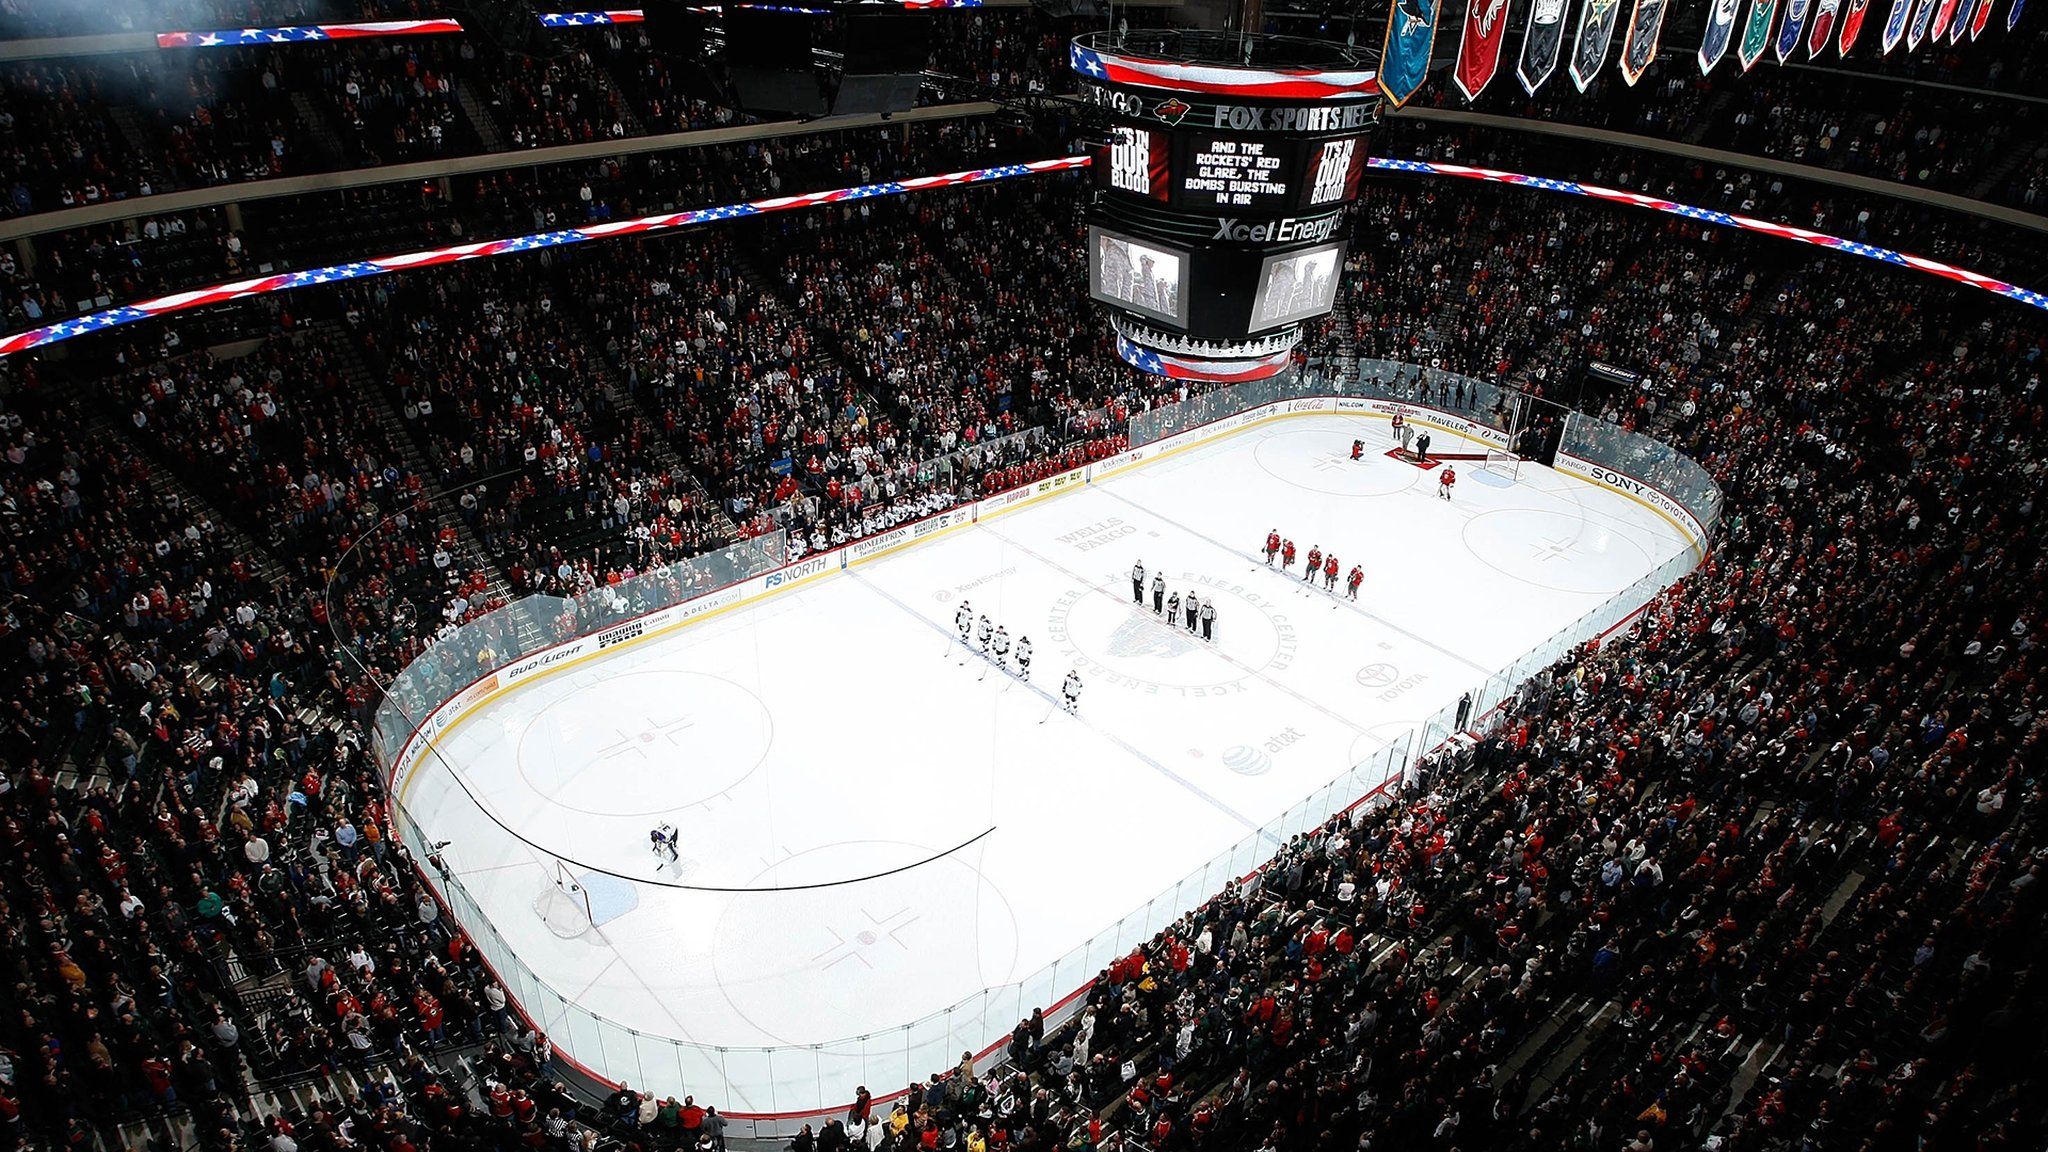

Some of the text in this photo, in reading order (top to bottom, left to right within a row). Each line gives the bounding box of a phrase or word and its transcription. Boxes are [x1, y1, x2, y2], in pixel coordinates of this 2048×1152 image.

[1214, 104, 1367, 131] FOX SPORTS NET
[1135, 129, 1149, 150] IN
[1211, 141, 1264, 155] AND THE
[1321, 138, 1357, 160] IT'S IN
[1111, 143, 1149, 179] OUR
[1196, 153, 1280, 169] ROCKETS' RED
[1315, 155, 1351, 187] OUR
[1111, 168, 1150, 195] BLOOD
[1199, 167, 1270, 181] GLARE, THE
[1185, 178, 1286, 195] BOMBS BURSTING
[1310, 183, 1345, 205] BLOOD
[1216, 193, 1252, 205] IN AIR
[1212, 217, 1276, 242] Xcel
[1277, 217, 1335, 243] Energy
[1593, 362, 1637, 379] BUD LIGHT
[1426, 414, 1469, 433] TRAVELERS
[1492, 433, 1509, 444] Xcel
[1560, 458, 1587, 472] FARGO
[1591, 467, 1646, 496] SONY
[1660, 498, 1687, 524] TOYOTA
[853, 535, 886, 553] PIONEER
[885, 529, 907, 541] PRESS
[1055, 517, 1124, 545] WELLS
[1074, 525, 1137, 551] FARGO
[691, 600, 719, 614] DELTA
[1183, 571, 1275, 609] ENERGY
[1272, 614, 1298, 671] CENTER
[1048, 589, 1249, 697] XCEL ENERGY CENTER
[509, 644, 584, 679] BUD LIGHT
[1375, 671, 1431, 704] TOYOTA
[448, 702, 462, 716] at&t
[1264, 726, 1306, 754] at&t
